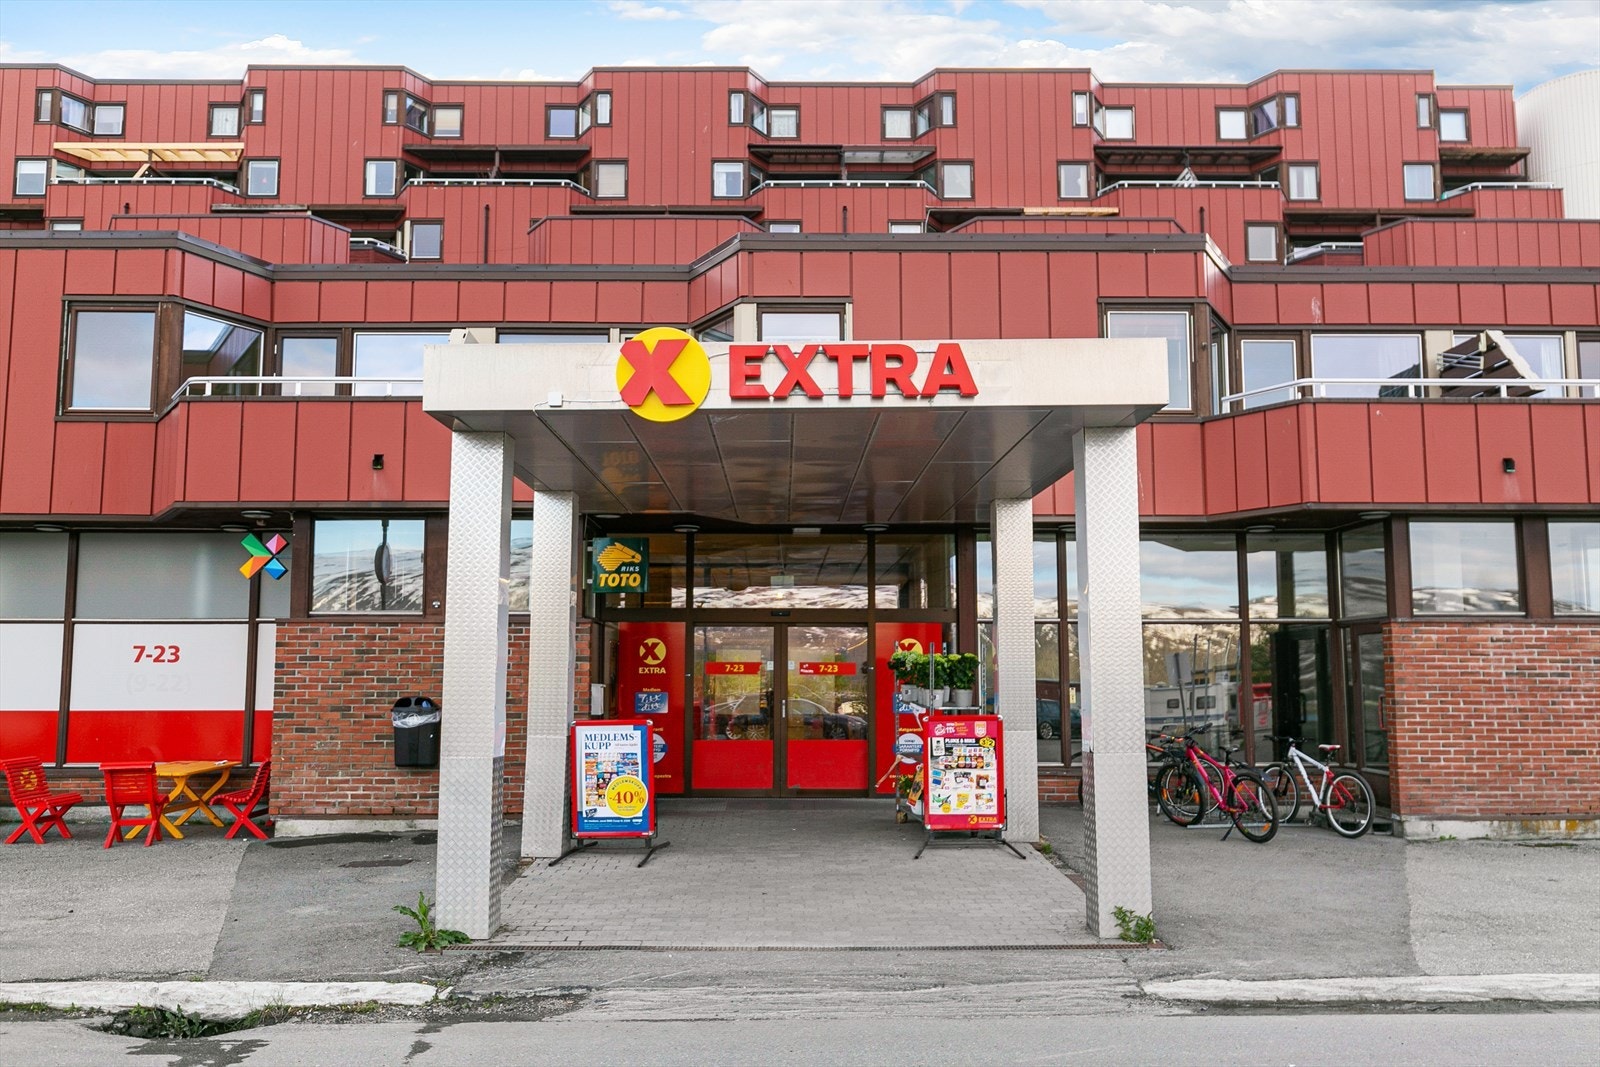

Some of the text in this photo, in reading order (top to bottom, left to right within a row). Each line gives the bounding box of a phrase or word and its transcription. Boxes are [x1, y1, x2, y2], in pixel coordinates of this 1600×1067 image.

[729, 343, 979, 400] EXTRA
[599, 573, 641, 588] TOTO
[133, 645, 180, 663] 7-23
[818, 664, 838, 672] 7-23
[584, 733, 638, 741] MEDLEMS-
[610, 791, 644, 804] -40%
